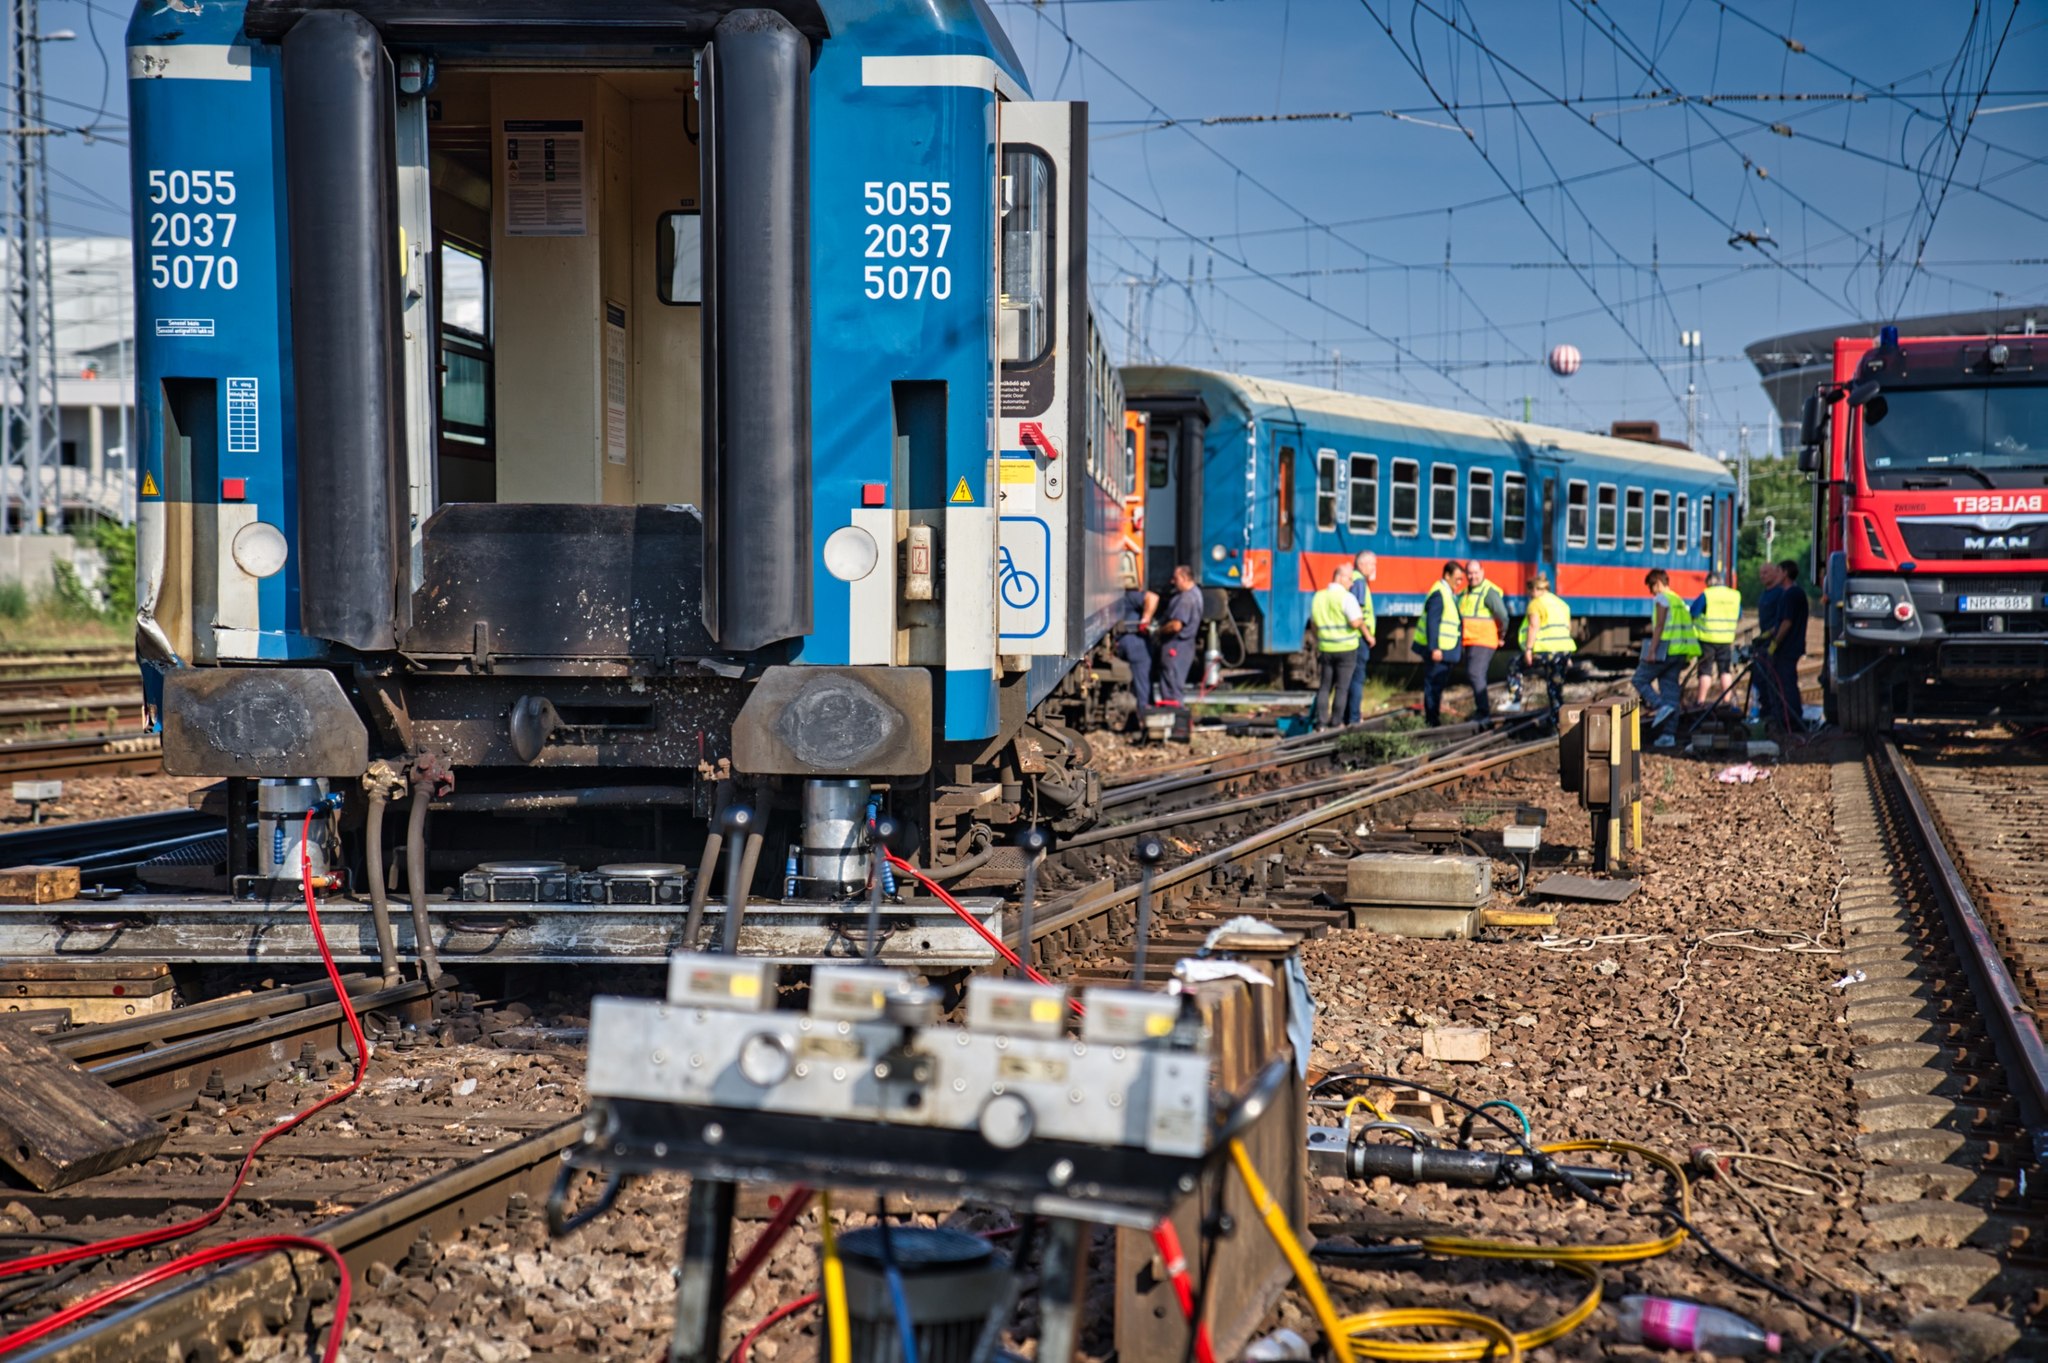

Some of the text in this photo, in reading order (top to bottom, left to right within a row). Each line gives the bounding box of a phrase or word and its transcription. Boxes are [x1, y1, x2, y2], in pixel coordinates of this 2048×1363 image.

[149, 170, 236, 205] 5055
[864, 181, 952, 216] 5055
[151, 212, 237, 248] 2037
[864, 223, 952, 258] 2037
[151, 255, 239, 290] 5070
[864, 265, 952, 300] 5070
[1964, 536, 2030, 550] MAN
